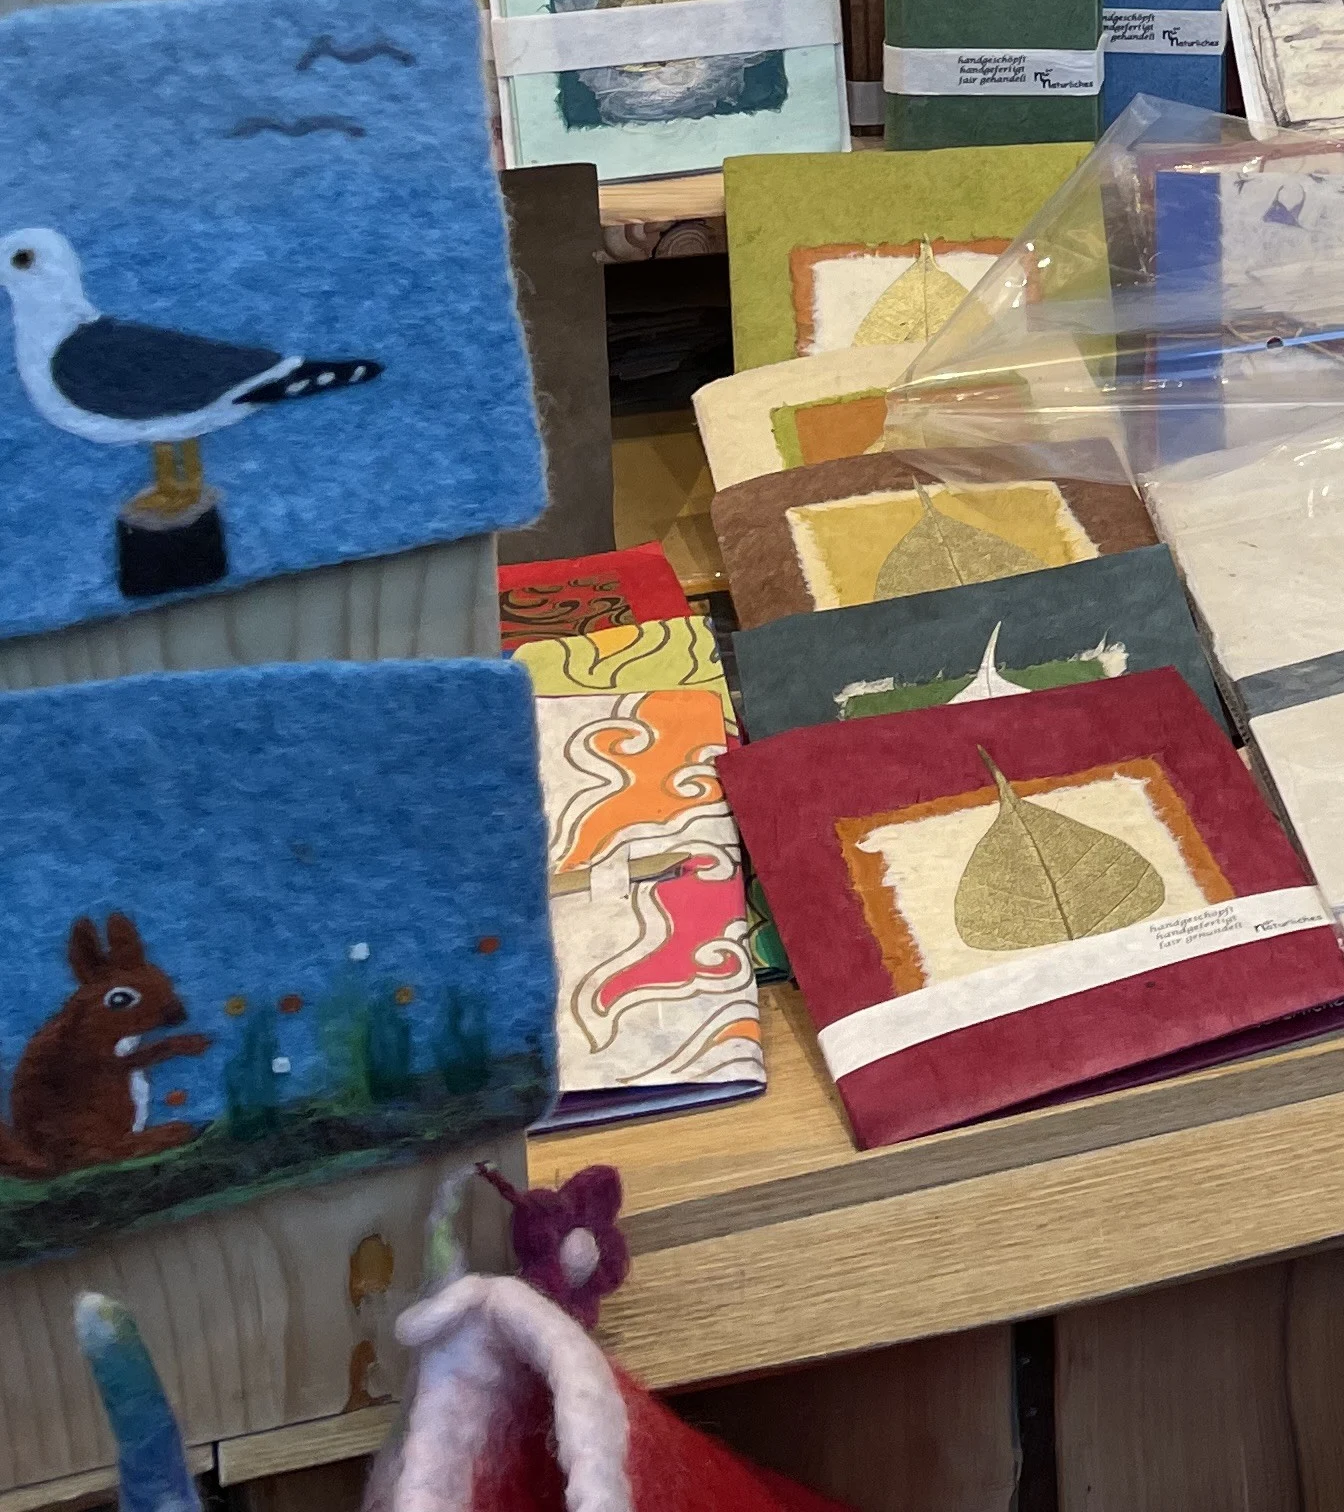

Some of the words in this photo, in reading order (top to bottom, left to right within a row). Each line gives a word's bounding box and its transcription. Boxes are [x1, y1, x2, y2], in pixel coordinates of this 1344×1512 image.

[1102, 13, 1155, 23] ndgeschöpft
[1103, 23, 1153, 34] ndgefertigt
[958, 55, 1027, 66] handgeschöpft
[960, 65, 1025, 76] handgefertigt
[959, 74, 976, 85] fair
[980, 74, 1026, 85] gehandelt
